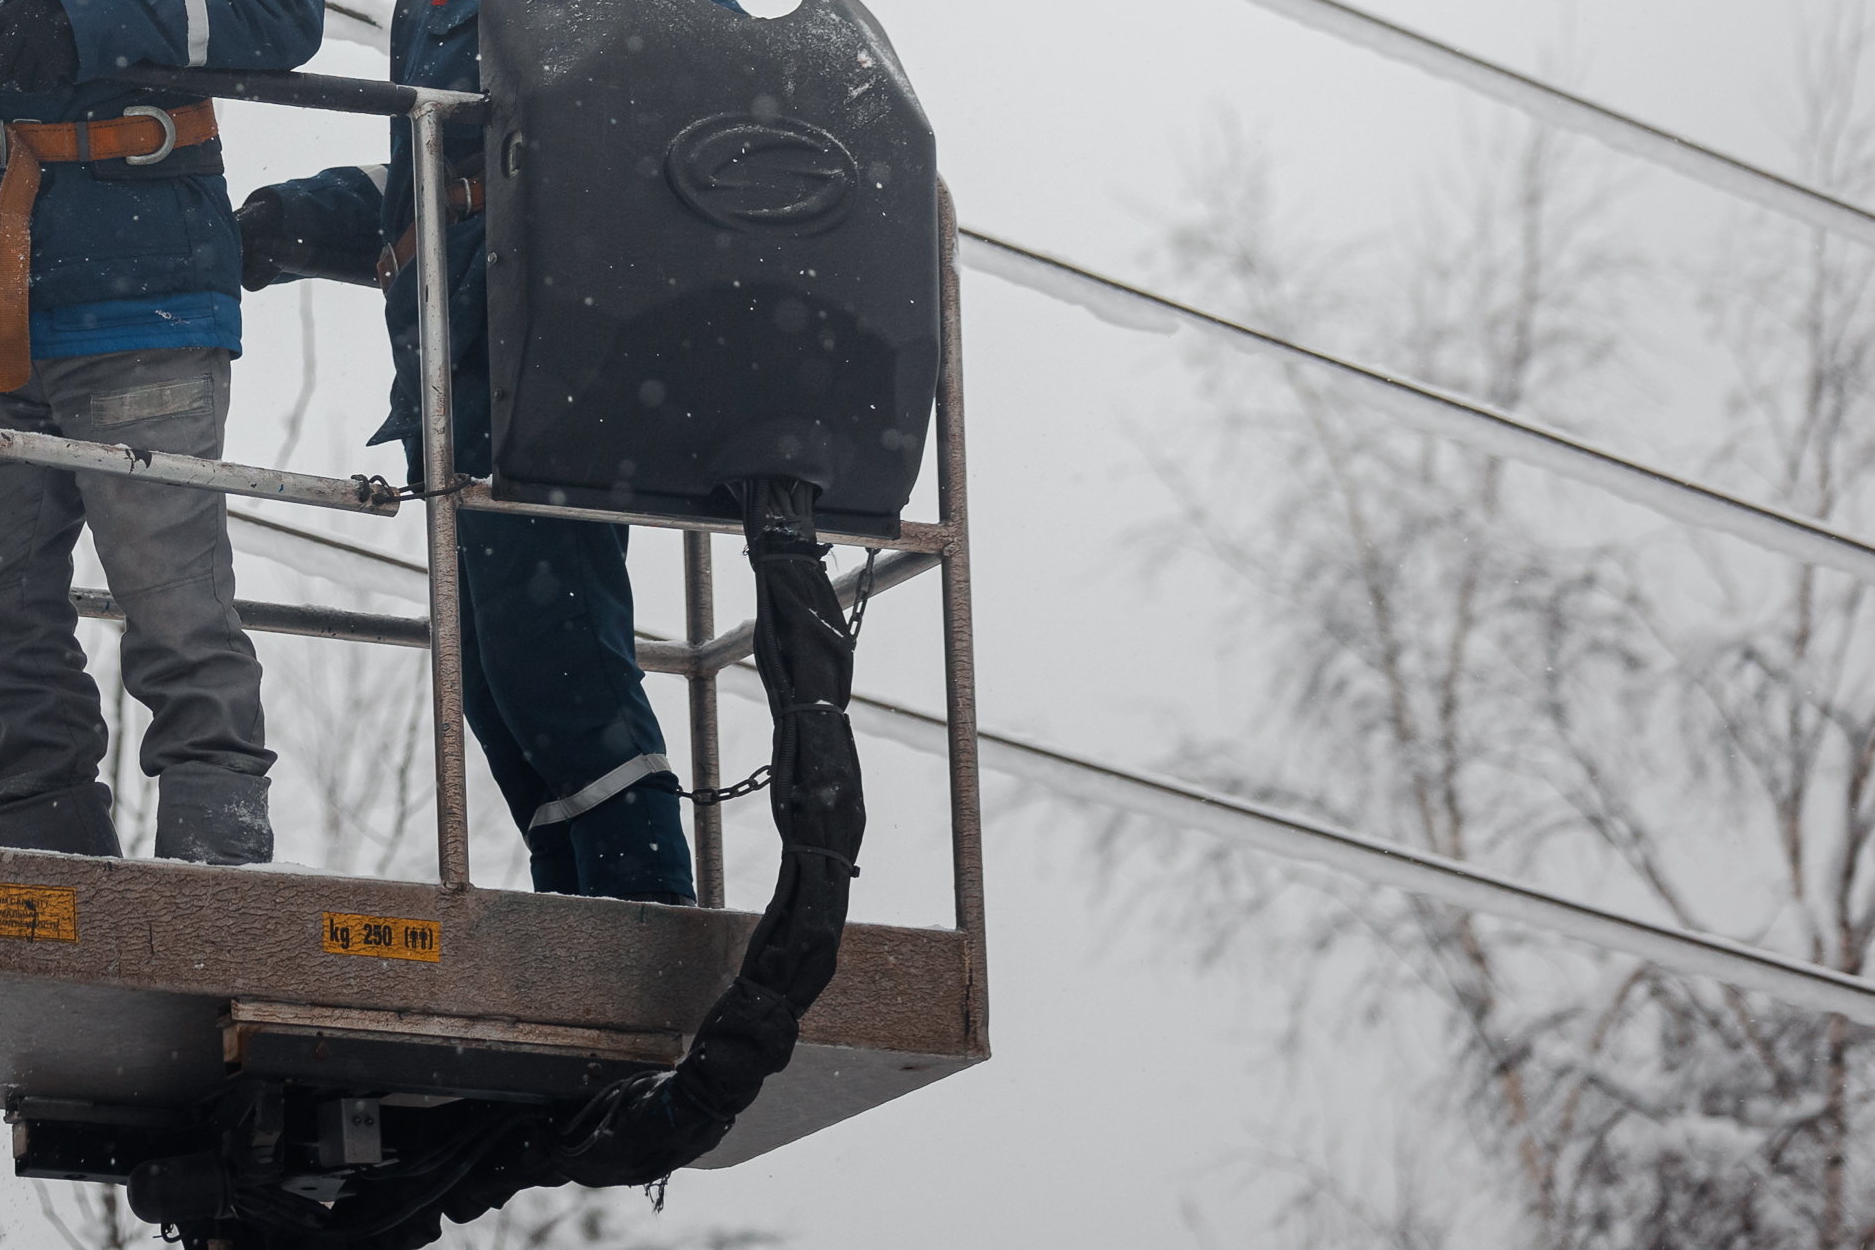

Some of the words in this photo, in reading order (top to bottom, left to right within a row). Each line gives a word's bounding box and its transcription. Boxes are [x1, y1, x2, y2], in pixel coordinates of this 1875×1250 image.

[10, 897, 49, 909] CAPCITY
[329, 918, 350, 950] kg
[363, 923, 393, 947] 250
